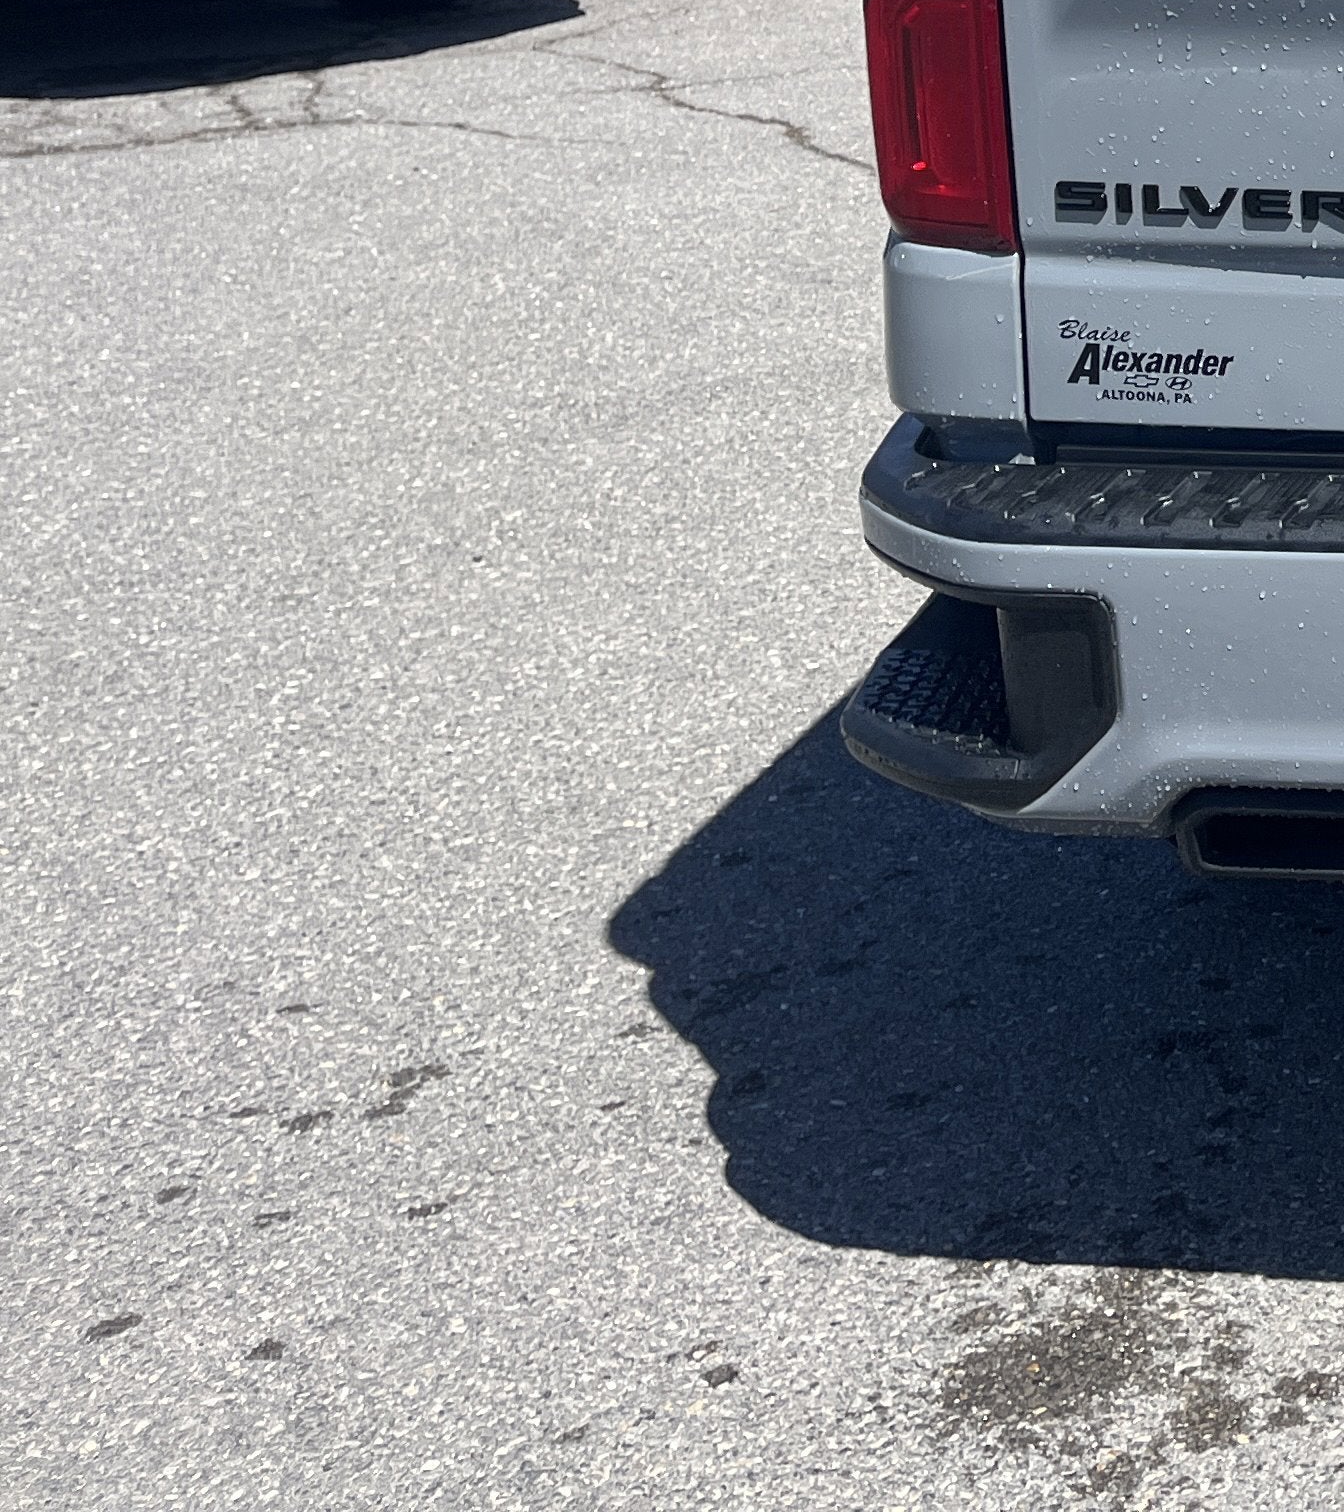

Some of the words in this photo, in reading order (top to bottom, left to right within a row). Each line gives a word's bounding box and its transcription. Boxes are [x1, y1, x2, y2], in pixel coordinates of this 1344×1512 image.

[1058, 319, 1132, 343] Blaise
[1067, 342, 1235, 385] Alexander
[1100, 389, 1170, 405] ALTOONA,
[1174, 392, 1193, 404] PA
